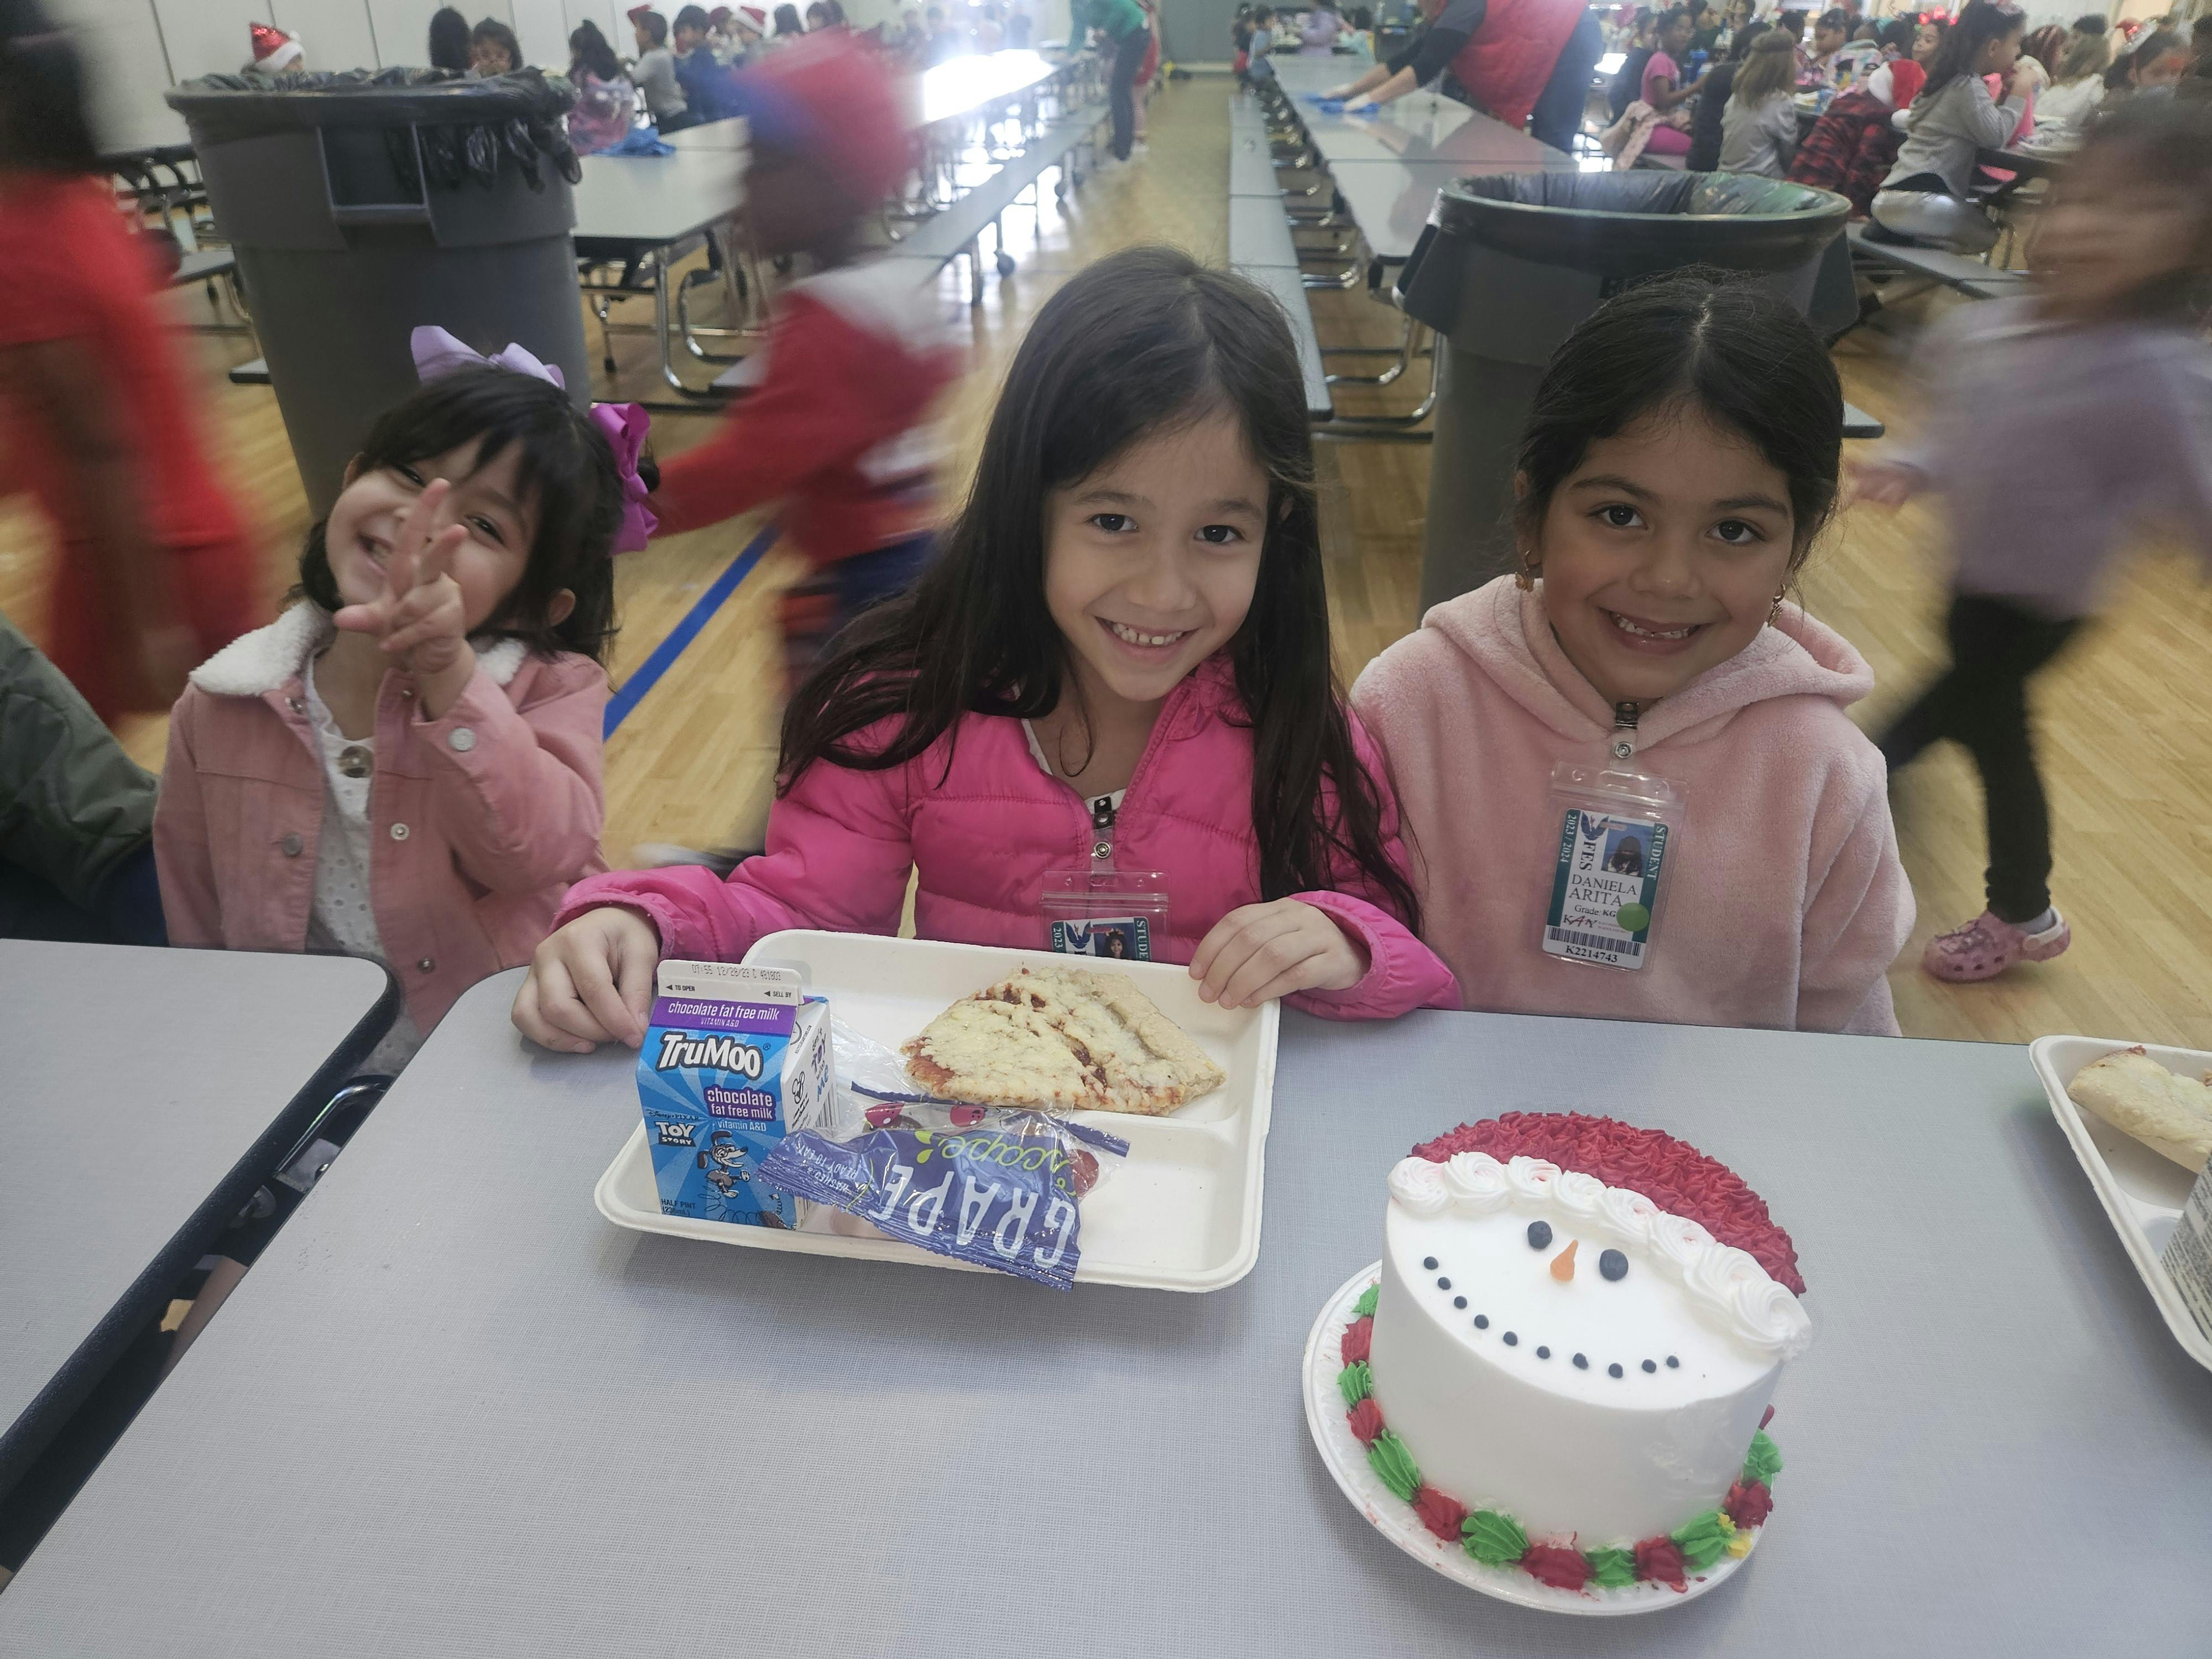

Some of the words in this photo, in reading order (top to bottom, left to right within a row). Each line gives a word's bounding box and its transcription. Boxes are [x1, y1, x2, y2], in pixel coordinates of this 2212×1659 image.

[1565, 815, 1577, 835] 2023
[1559, 842, 1571, 863] 2024
[1579, 840, 1596, 871] FES
[1647, 826, 1666, 880] STUDENT
[1571, 874, 1637, 895] DANIELA
[1568, 886, 1623, 907] ARITA
[1574, 905, 1601, 916] Grade:
[1603, 909, 1616, 918] KG
[1053, 926, 1062, 948] 2023
[1136, 920, 1149, 961] STUDE
[1566, 945, 1618, 963] K2214743
[669, 1001, 718, 1016] chocolate
[718, 1004, 734, 1018] fat
[734, 1005, 755, 1019] free
[757, 1007, 779, 1020] milk
[701, 1017, 724, 1026] VITAMIN
[725, 1019, 739, 1027] A&D
[658, 1033, 762, 1078] TruMoo
[707, 1087, 773, 1107] chocolate
[711, 1104, 726, 1116] fat
[728, 1105, 748, 1118] free
[751, 1107, 773, 1119] milk
[718, 1120, 748, 1130] vitamin
[749, 1122, 766, 1132] A&D
[662, 1136, 692, 1145] STORY
[799, 1145, 816, 1160] EAT
[815, 1154, 827, 1167] TO
[827, 1161, 857, 1181] READY
[680, 1201, 696, 1209] PINT
[868, 1164, 1077, 1269] GRAPE
